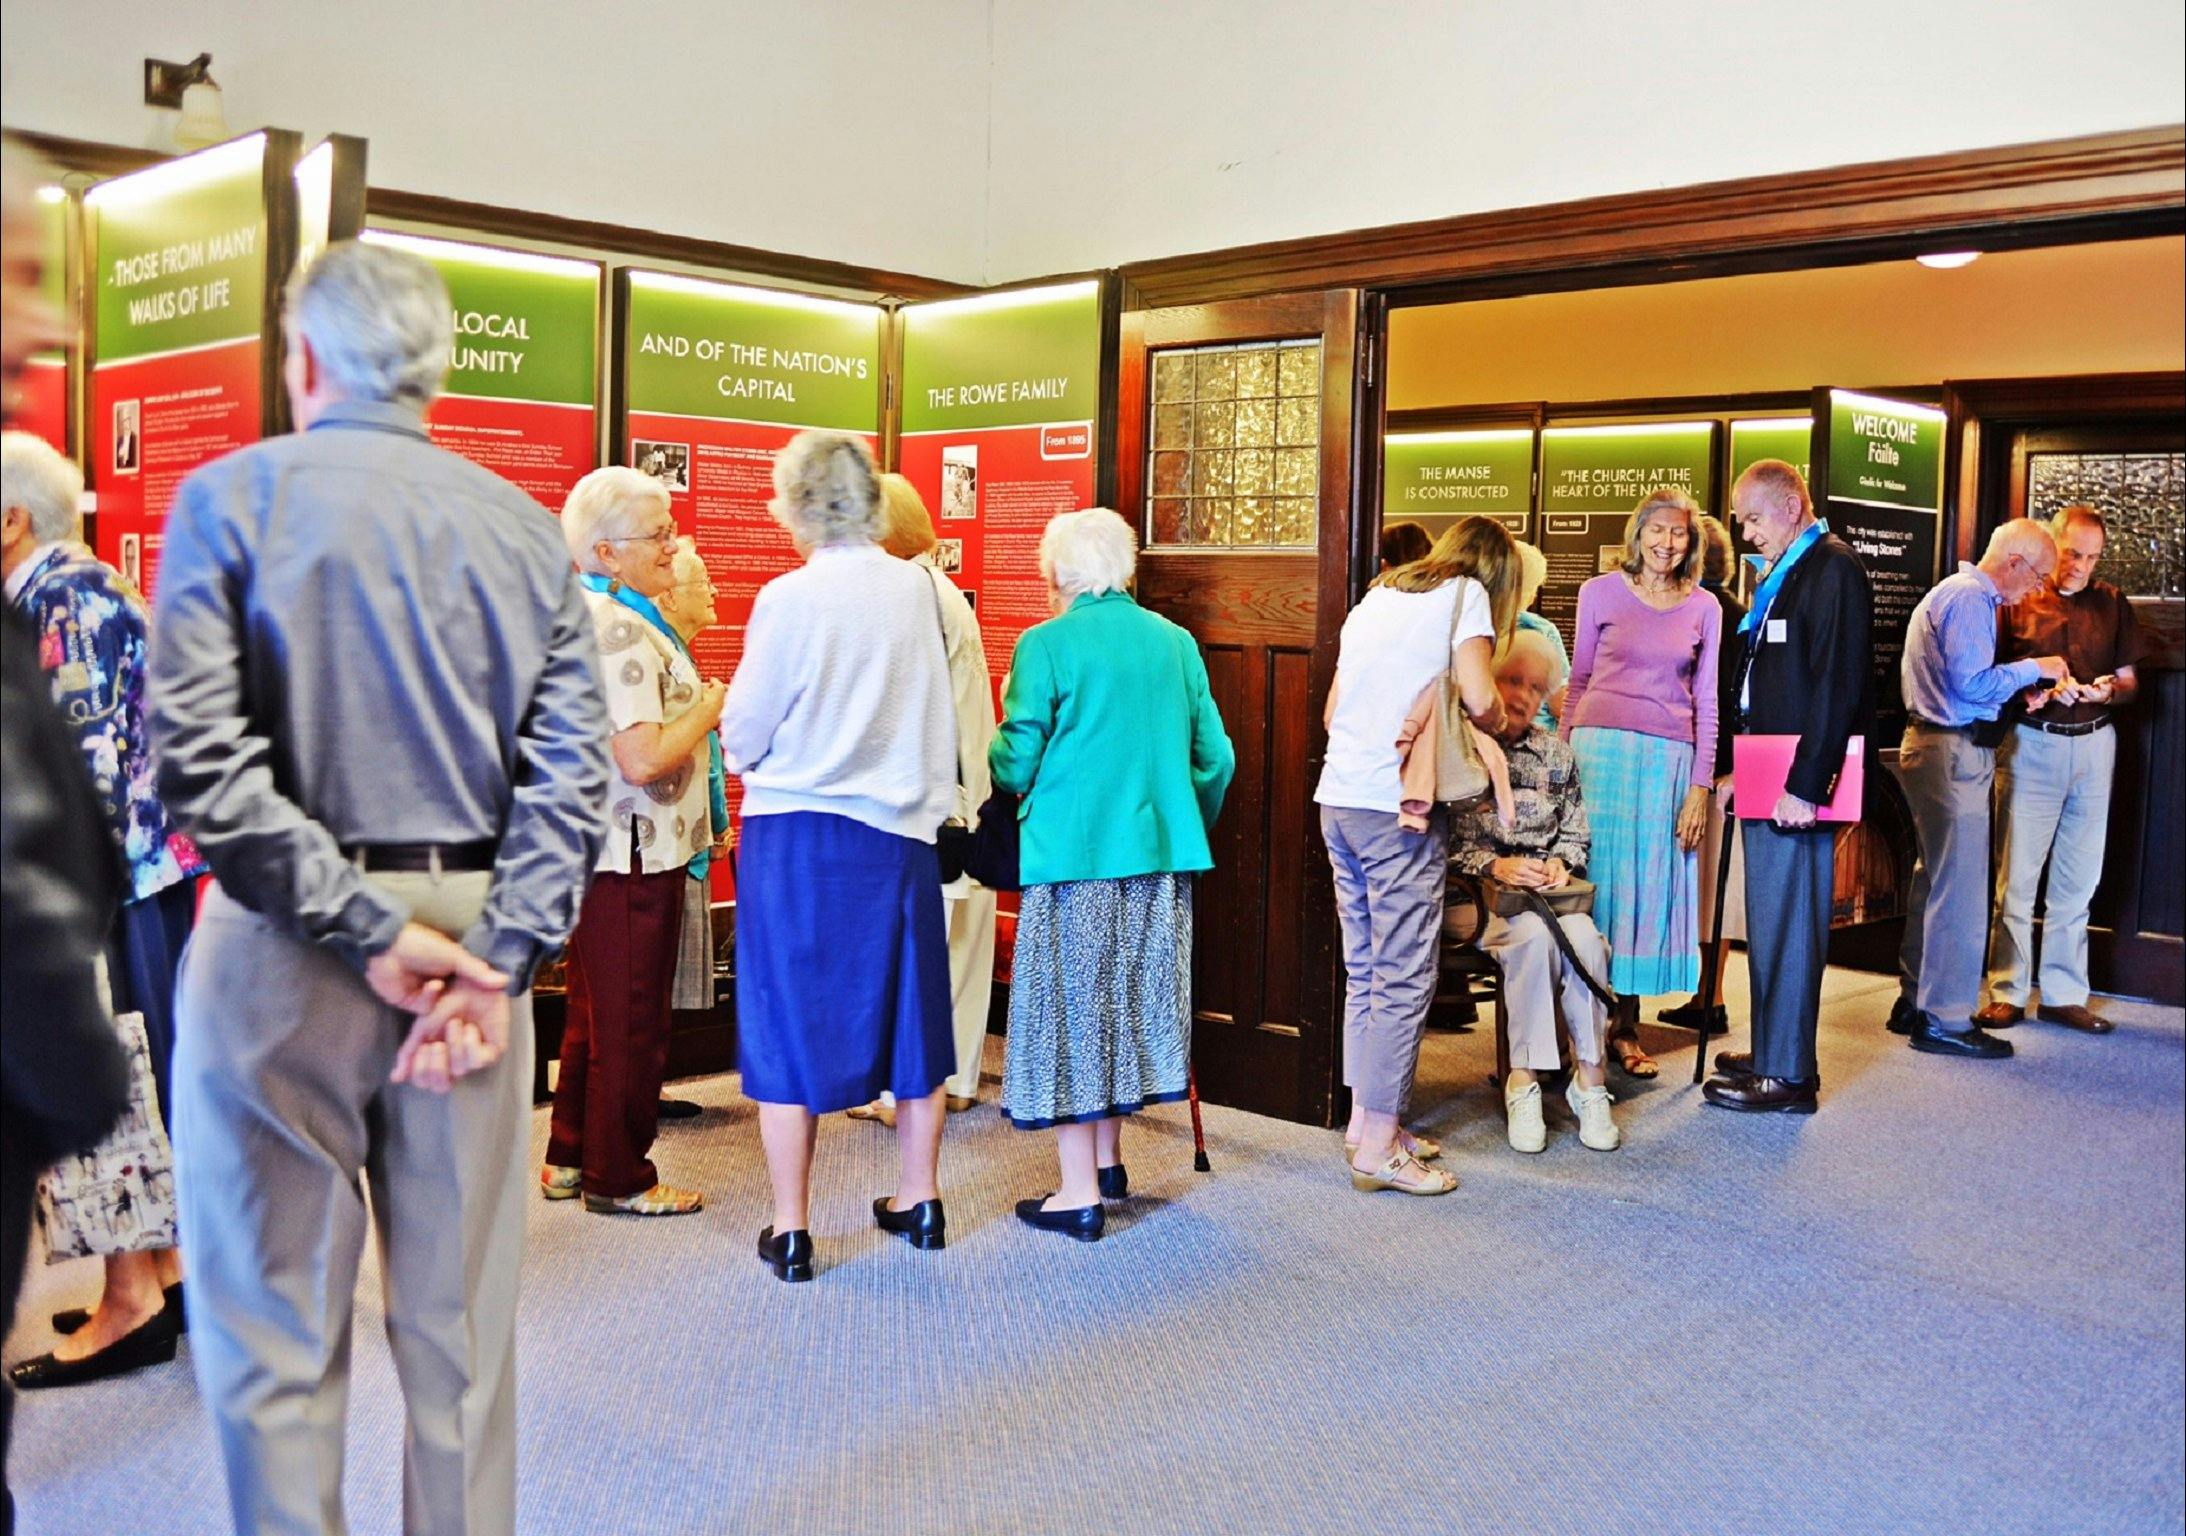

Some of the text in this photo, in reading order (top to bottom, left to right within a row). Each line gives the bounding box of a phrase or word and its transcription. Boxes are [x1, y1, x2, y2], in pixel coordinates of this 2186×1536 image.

[162, 242, 204, 274] FROM
[208, 226, 256, 263] MANY
[130, 278, 230, 326] WALKS OF LIFE
[453, 310, 530, 340] LOCAL
[451, 346, 524, 374] UNITY
[640, 333, 868, 379] AND OF THE NATION'S
[718, 374, 796, 402] CAPITAL
[928, 377, 1069, 409] THE ROWE FAMILY
[1046, 436, 1066, 446] From
[1852, 412, 1918, 444] WELCOME
[1420, 465, 1491, 480] THE MANSE
[1592, 468, 1645, 483] CHURCH
[1649, 468, 1664, 482] AT
[1667, 467, 1691, 482] THE
[1405, 485, 1509, 499] IS CONSTRUCTED
[1552, 484, 1589, 498] HEART
[1592, 484, 1612, 498] OF
[1613, 483, 1636, 497] THE
